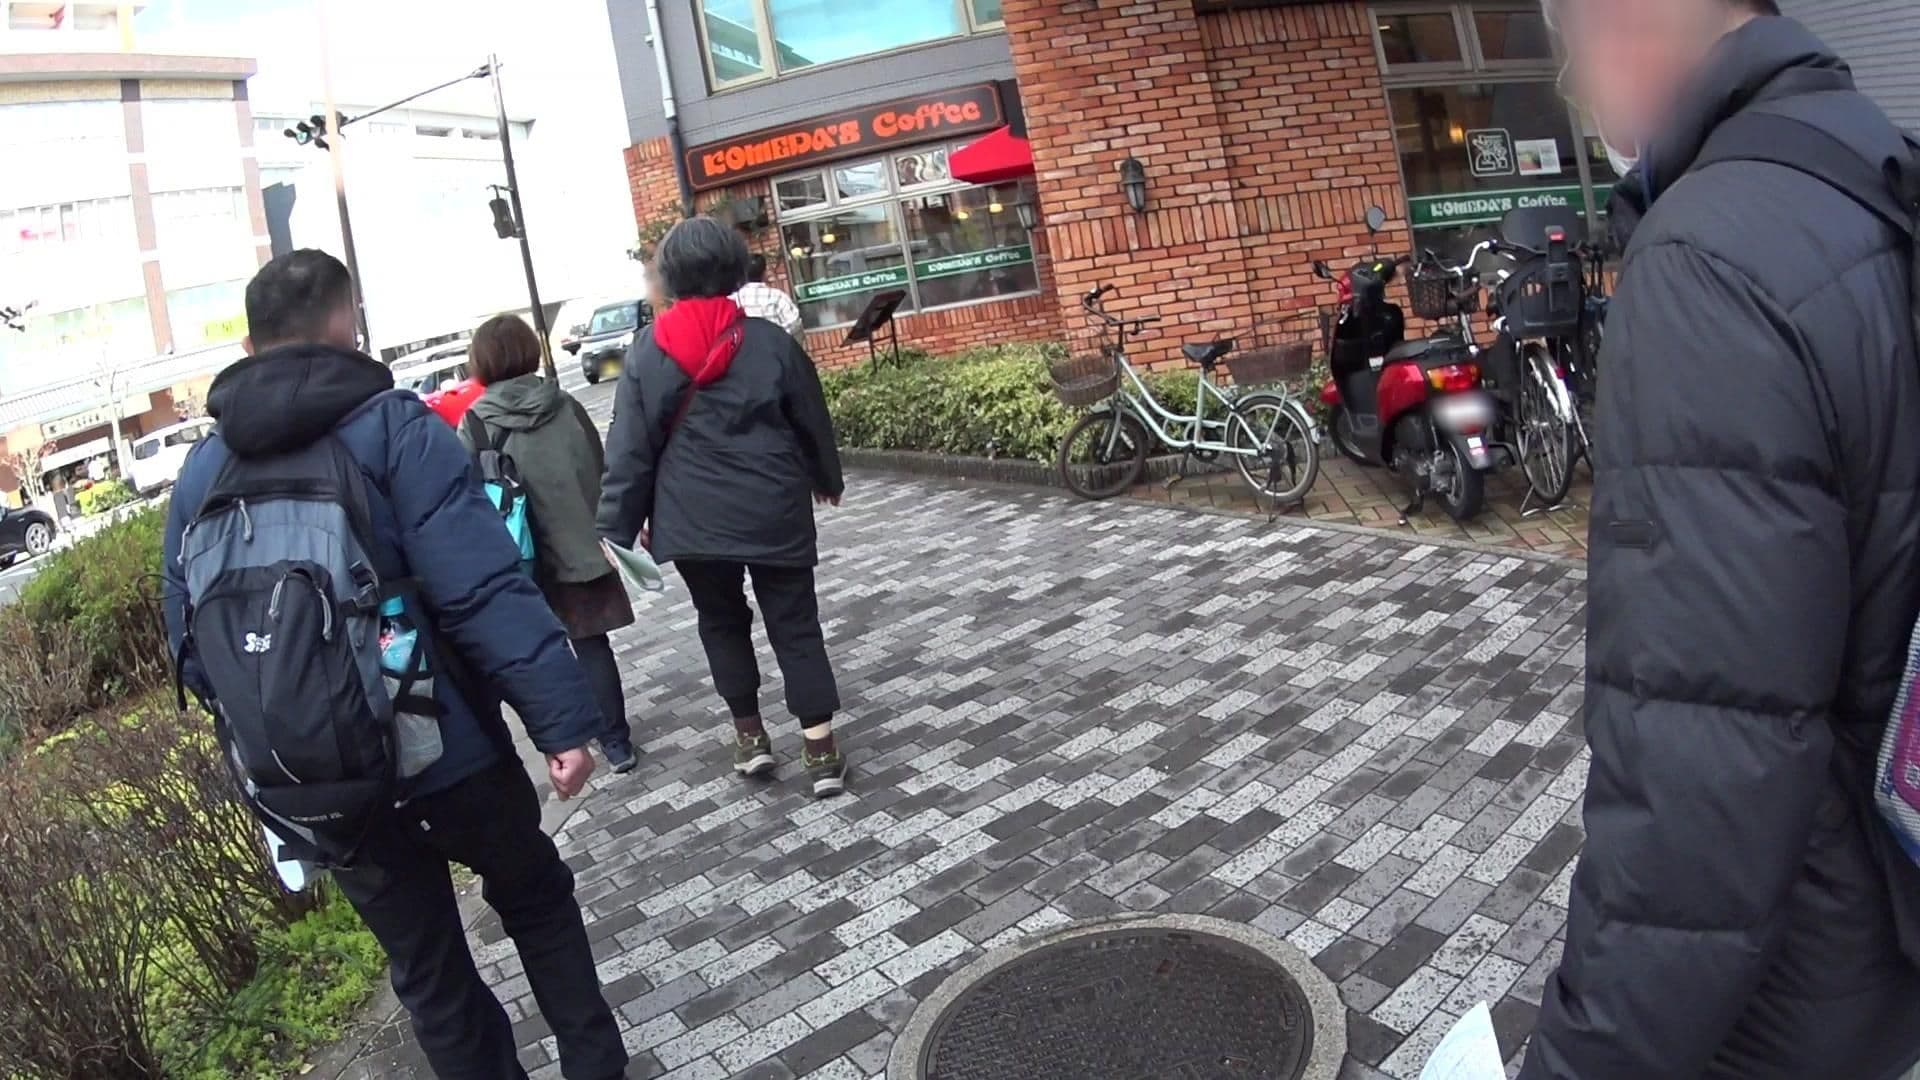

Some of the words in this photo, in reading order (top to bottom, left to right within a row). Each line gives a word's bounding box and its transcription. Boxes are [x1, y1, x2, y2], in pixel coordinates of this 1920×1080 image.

[703, 120, 861, 176] KOMEDA'S
[872, 101, 981, 137] Coffee
[1431, 197, 1512, 217] KOMEDA'S
[1518, 194, 1567, 208] Coffee
[862, 271, 897, 286] Coffee
